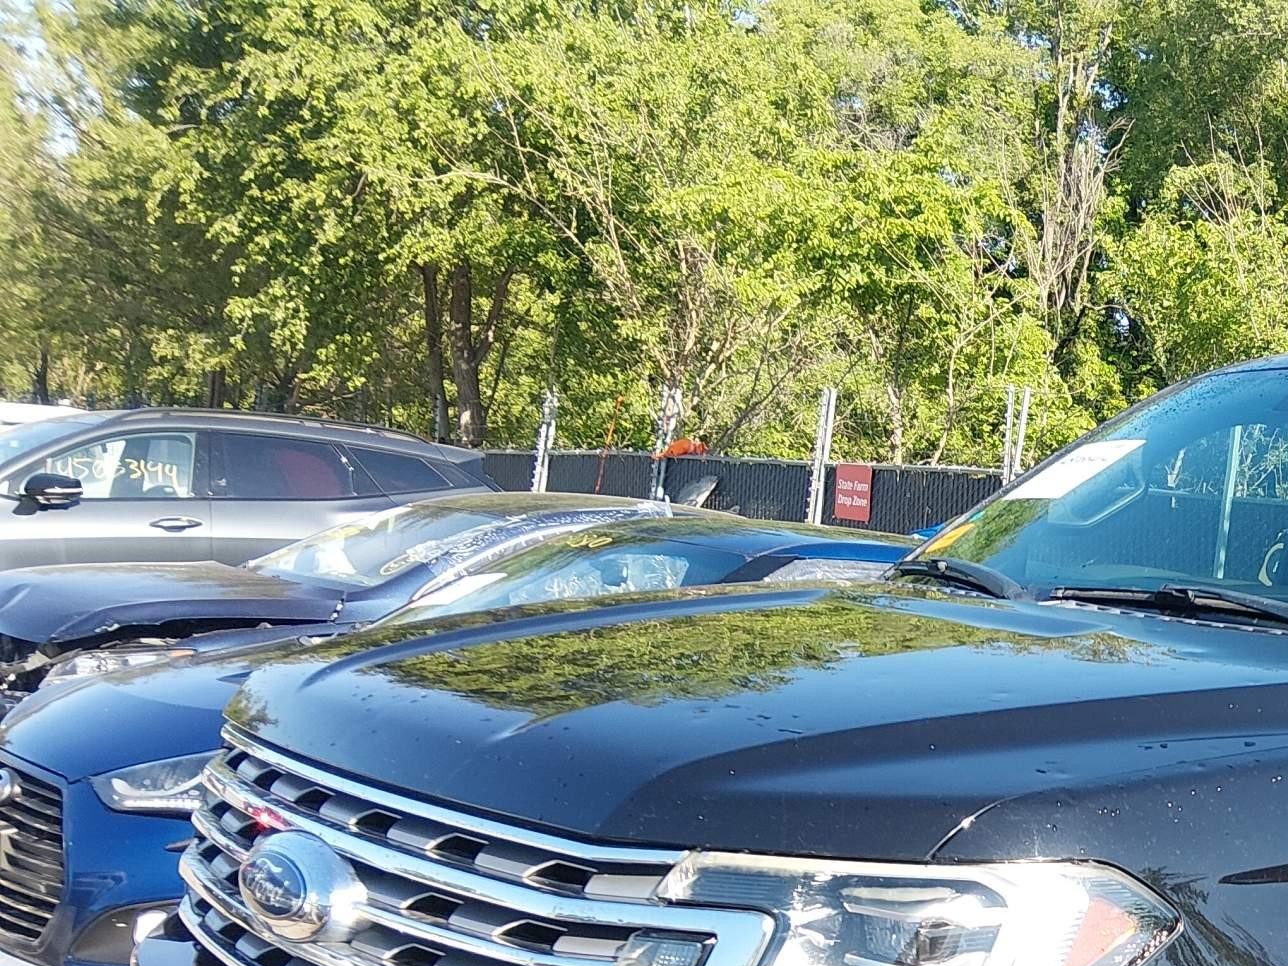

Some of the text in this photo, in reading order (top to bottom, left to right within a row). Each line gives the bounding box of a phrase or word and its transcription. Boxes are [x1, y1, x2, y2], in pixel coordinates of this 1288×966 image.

[838, 479, 869, 492] State Farm
[838, 494, 868, 508] Drop Zone
